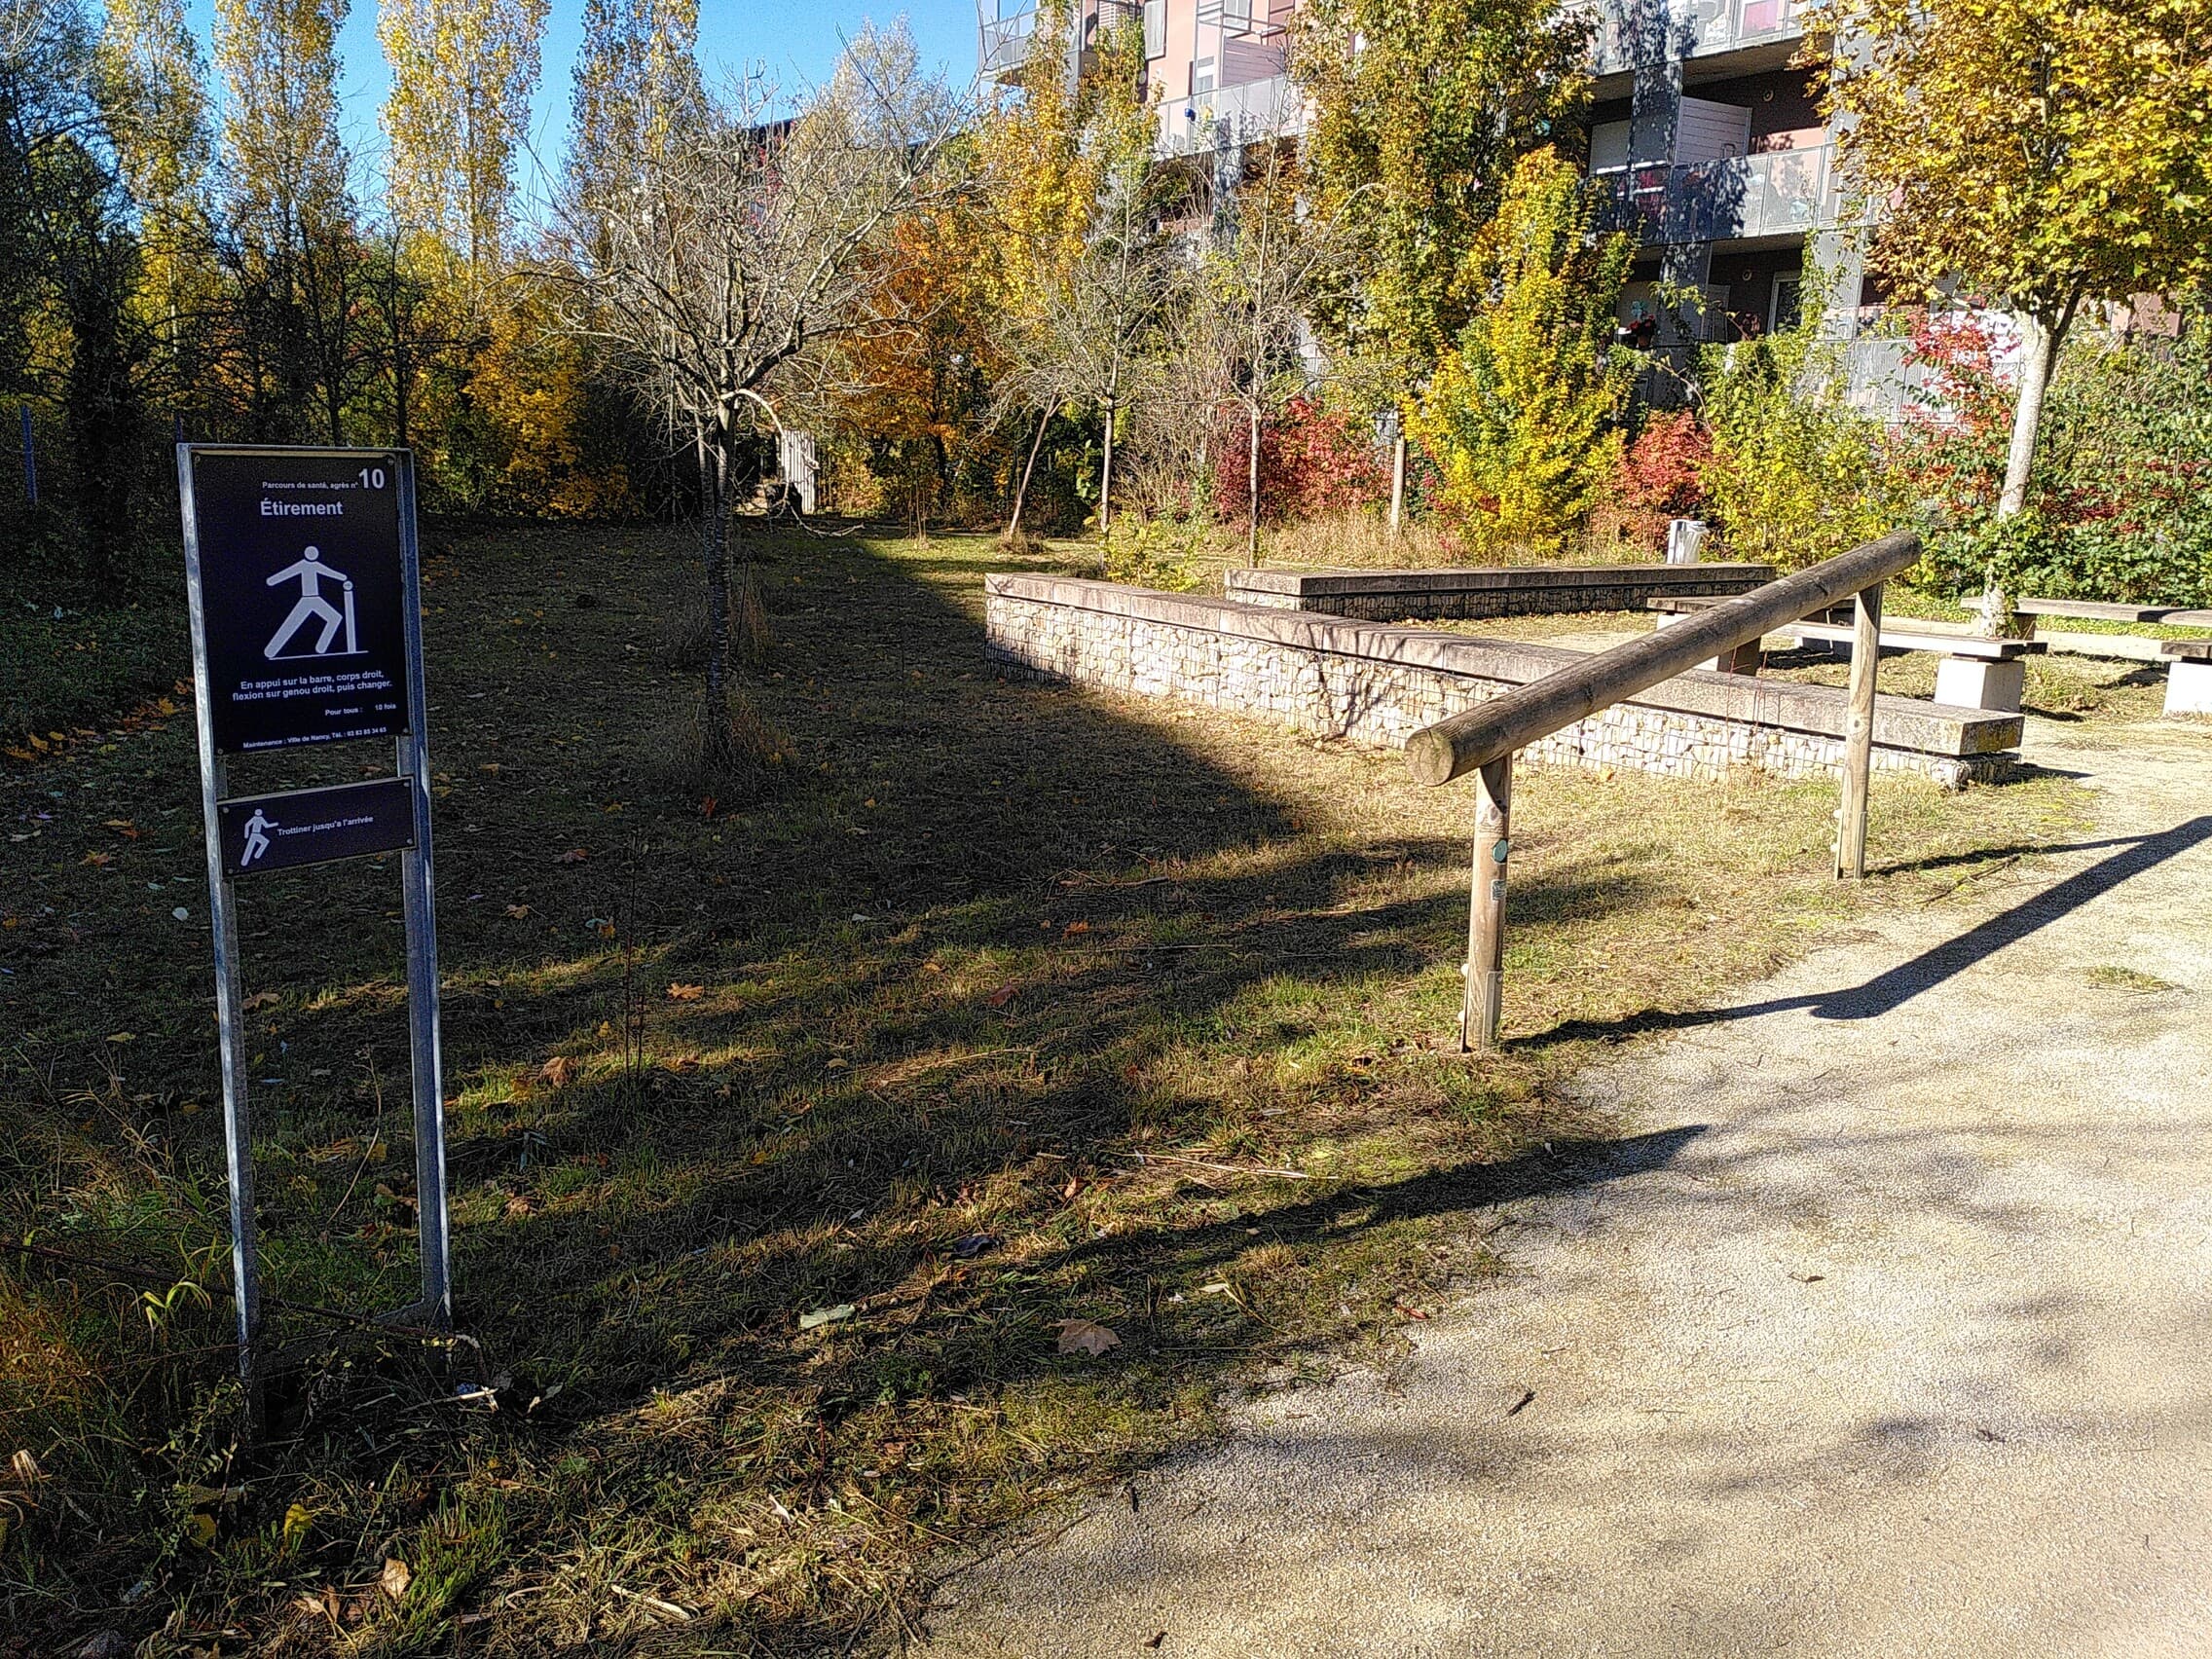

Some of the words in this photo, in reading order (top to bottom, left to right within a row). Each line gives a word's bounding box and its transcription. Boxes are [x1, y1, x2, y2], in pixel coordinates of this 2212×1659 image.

[358, 468, 385, 489] 10
[260, 498, 343, 515] Étirement
[240, 681, 253, 689] En
[256, 679, 280, 690] appui
[283, 678, 297, 686] sur
[310, 675, 334, 684] barre,
[337, 673, 359, 682] corps
[362, 670, 384, 680] droit,
[233, 691, 263, 701] flexion
[283, 688, 311, 698] genou
[313, 685, 335, 694] droit,
[337, 683, 354, 693] puis
[357, 680, 392, 691] changer.
[243, 739, 282, 748] Maintenance
[277, 825, 311, 836] Trottiner
[343, 815, 373, 827] l'arrivée
